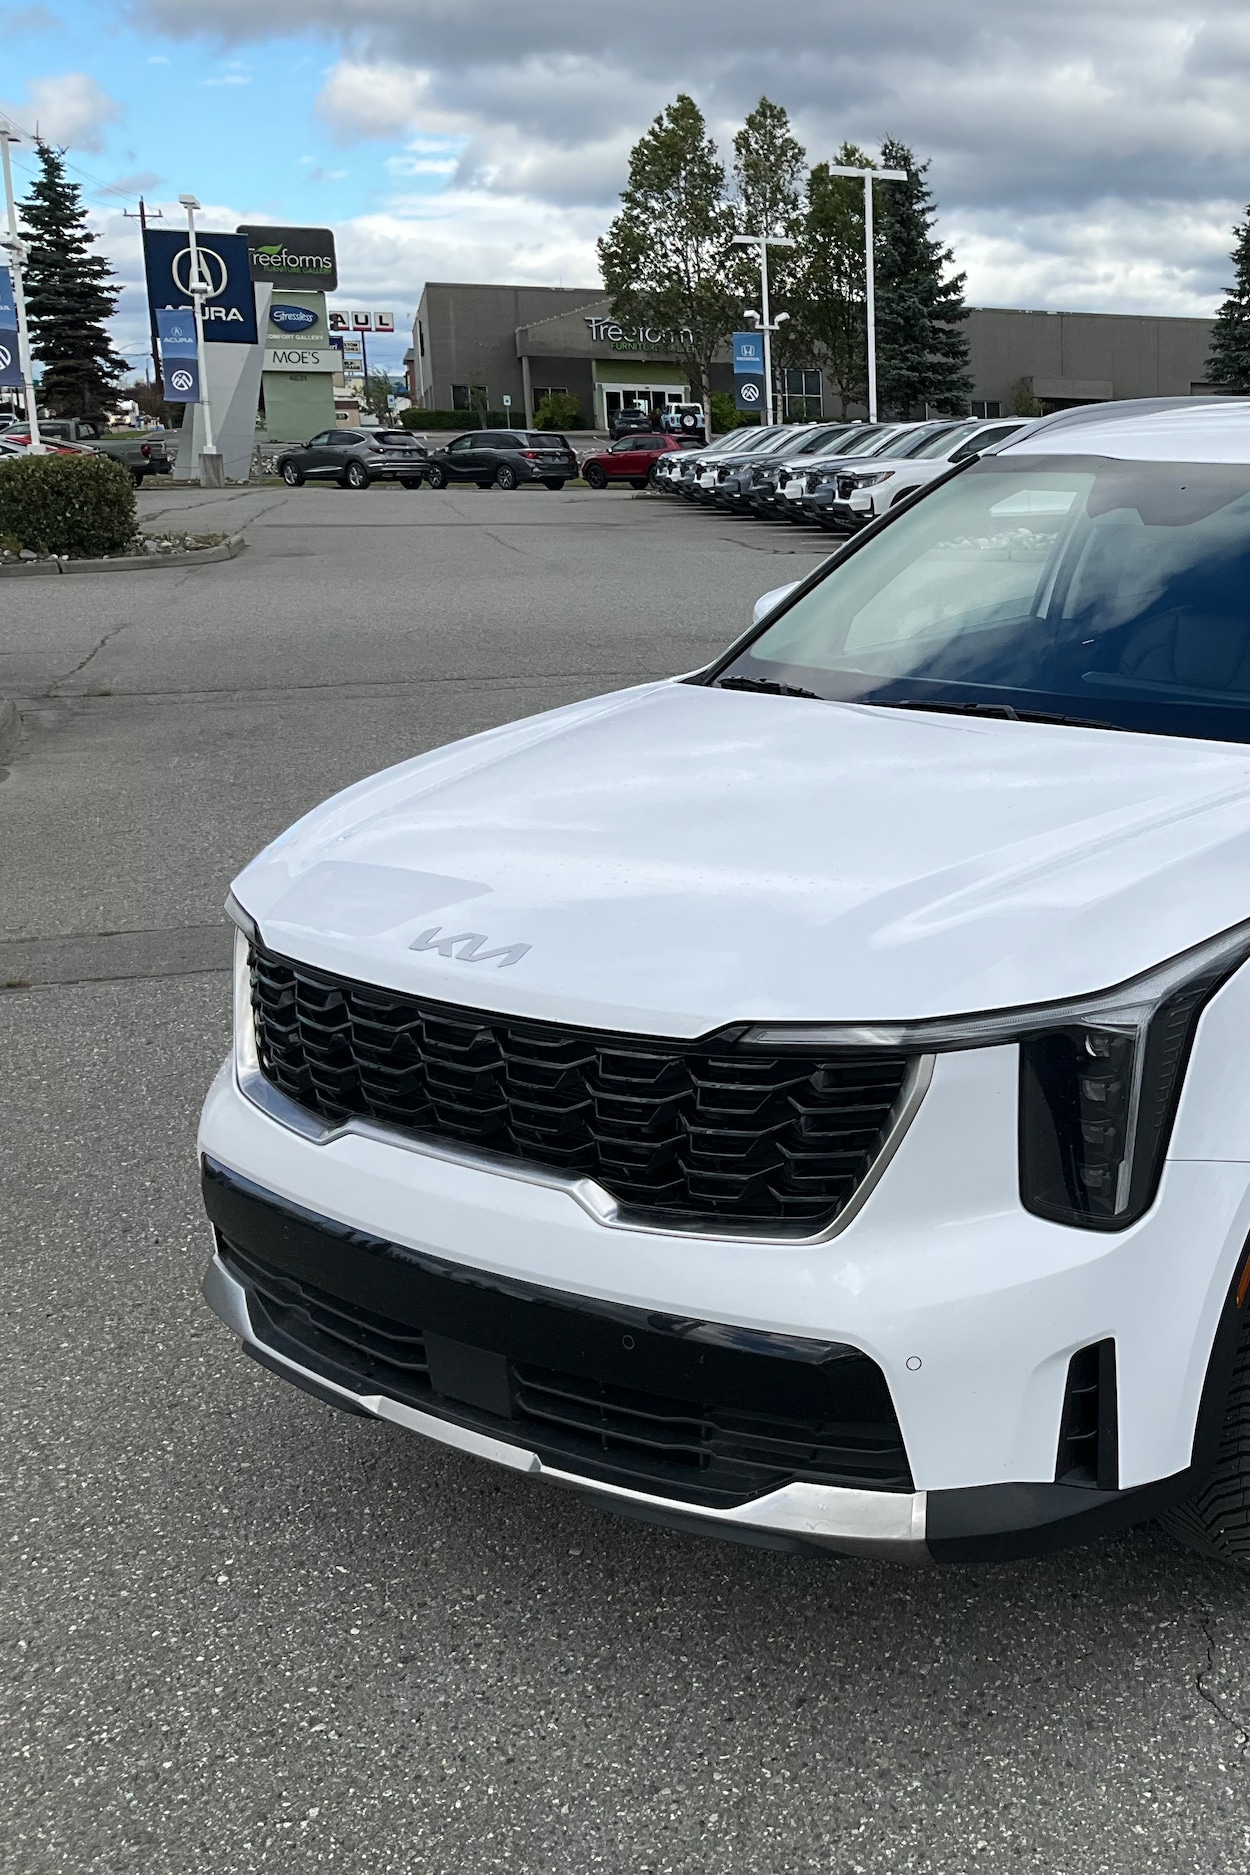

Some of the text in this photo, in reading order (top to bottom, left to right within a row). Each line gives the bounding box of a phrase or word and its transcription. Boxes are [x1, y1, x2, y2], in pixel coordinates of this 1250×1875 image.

[248, 248, 332, 269] reeforms
[164, 304, 244, 322] URA
[273, 310, 314, 322] Stressless
[273, 350, 320, 364] MOE'S
[408, 926, 532, 968] KIA
